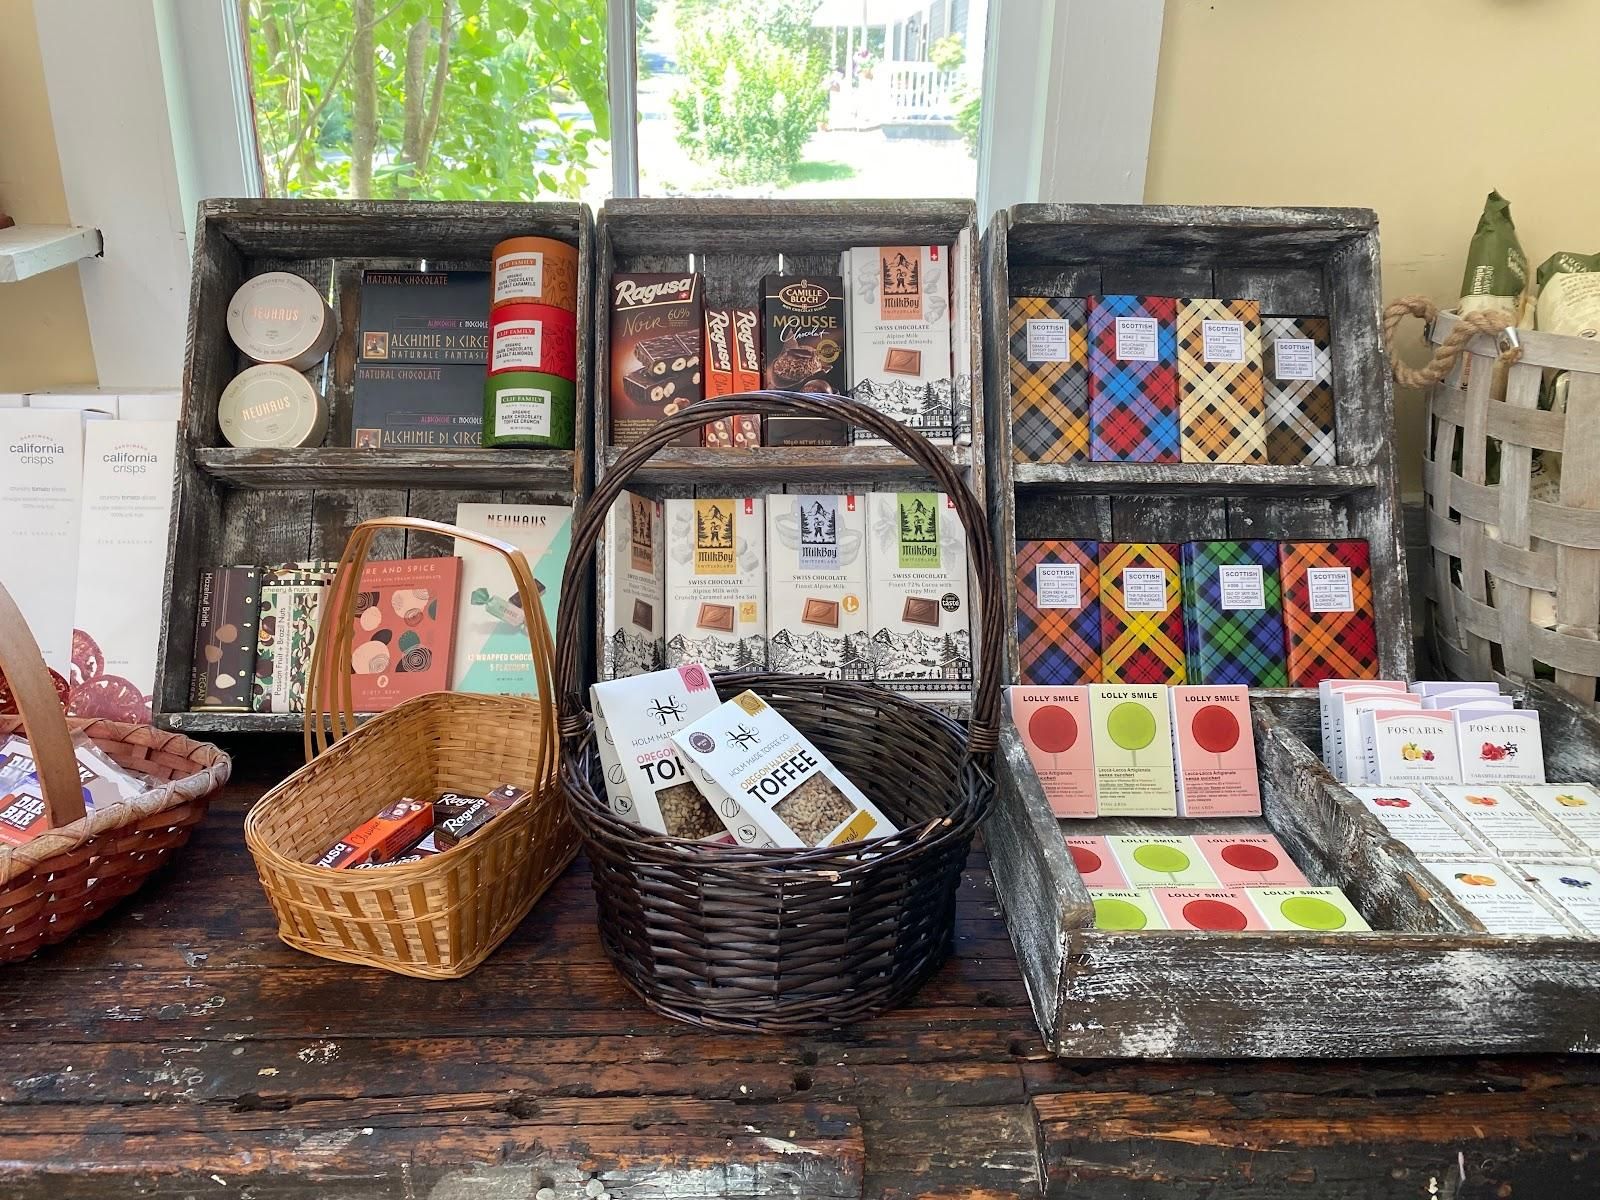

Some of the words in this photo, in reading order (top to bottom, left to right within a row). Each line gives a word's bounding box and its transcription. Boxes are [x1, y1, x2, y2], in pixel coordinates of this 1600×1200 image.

[366, 276, 401, 284] NATURAL
[405, 276, 448, 285] CHOCOLATE
[615, 278, 691, 306] Ragusa
[885, 298, 919, 308] MilkBoy
[622, 312, 664, 337] Noir
[667, 308, 690, 320] 60%
[773, 315, 837, 328] MOUSSE
[780, 319, 829, 342] Chocolat
[391, 334, 441, 348] ALCHIMIE
[446, 336, 456, 347] DI
[459, 335, 488, 348] CIRCE
[709, 311, 731, 371] Ragusa
[737, 311, 758, 371] Ragusa
[391, 350, 438, 358] NATURALE
[359, 370, 394, 379] NATURAL
[398, 370, 441, 379] CHOCOLATE
[242, 396, 290, 421] NEUHAUS
[384, 431, 434, 443] ALCHIMIE
[440, 433, 449, 443] DI
[453, 432, 482, 444] CIRCE
[9, 443, 64, 454] california
[20, 455, 54, 465] crisps
[103, 453, 157, 463] california
[113, 464, 146, 474] crisps
[488, 514, 546, 527] NEUHAUS
[698, 552, 733, 562] MilkBoy
[802, 547, 837, 558] MilkBoy
[903, 545, 937, 556] MilkBoy
[383, 566, 402, 574] AND
[408, 564, 435, 572] SPICE
[204, 572, 214, 606] Hazelnut
[200, 606, 210, 627] Brittle
[198, 672, 207, 701] VEGAN
[274, 670, 282, 696] Passion
[1388, 726, 1444, 735] FOSCARIS
[1470, 725, 1526, 733] FOSCARIS
[632, 736, 655, 747] HOLM
[656, 731, 676, 740] MADE
[728, 761, 746, 777] HOLM
[747, 752, 763, 766] MADE
[760, 741, 783, 758] TOFFEE
[741, 765, 772, 790] OREGON
[769, 743, 802, 770] HAZELNUT
[747, 750, 818, 803] TOFFEE
[14, 796, 45, 814] DAK
[0, 806, 35, 826] BAR
[443, 799, 486, 832] Ragusa
